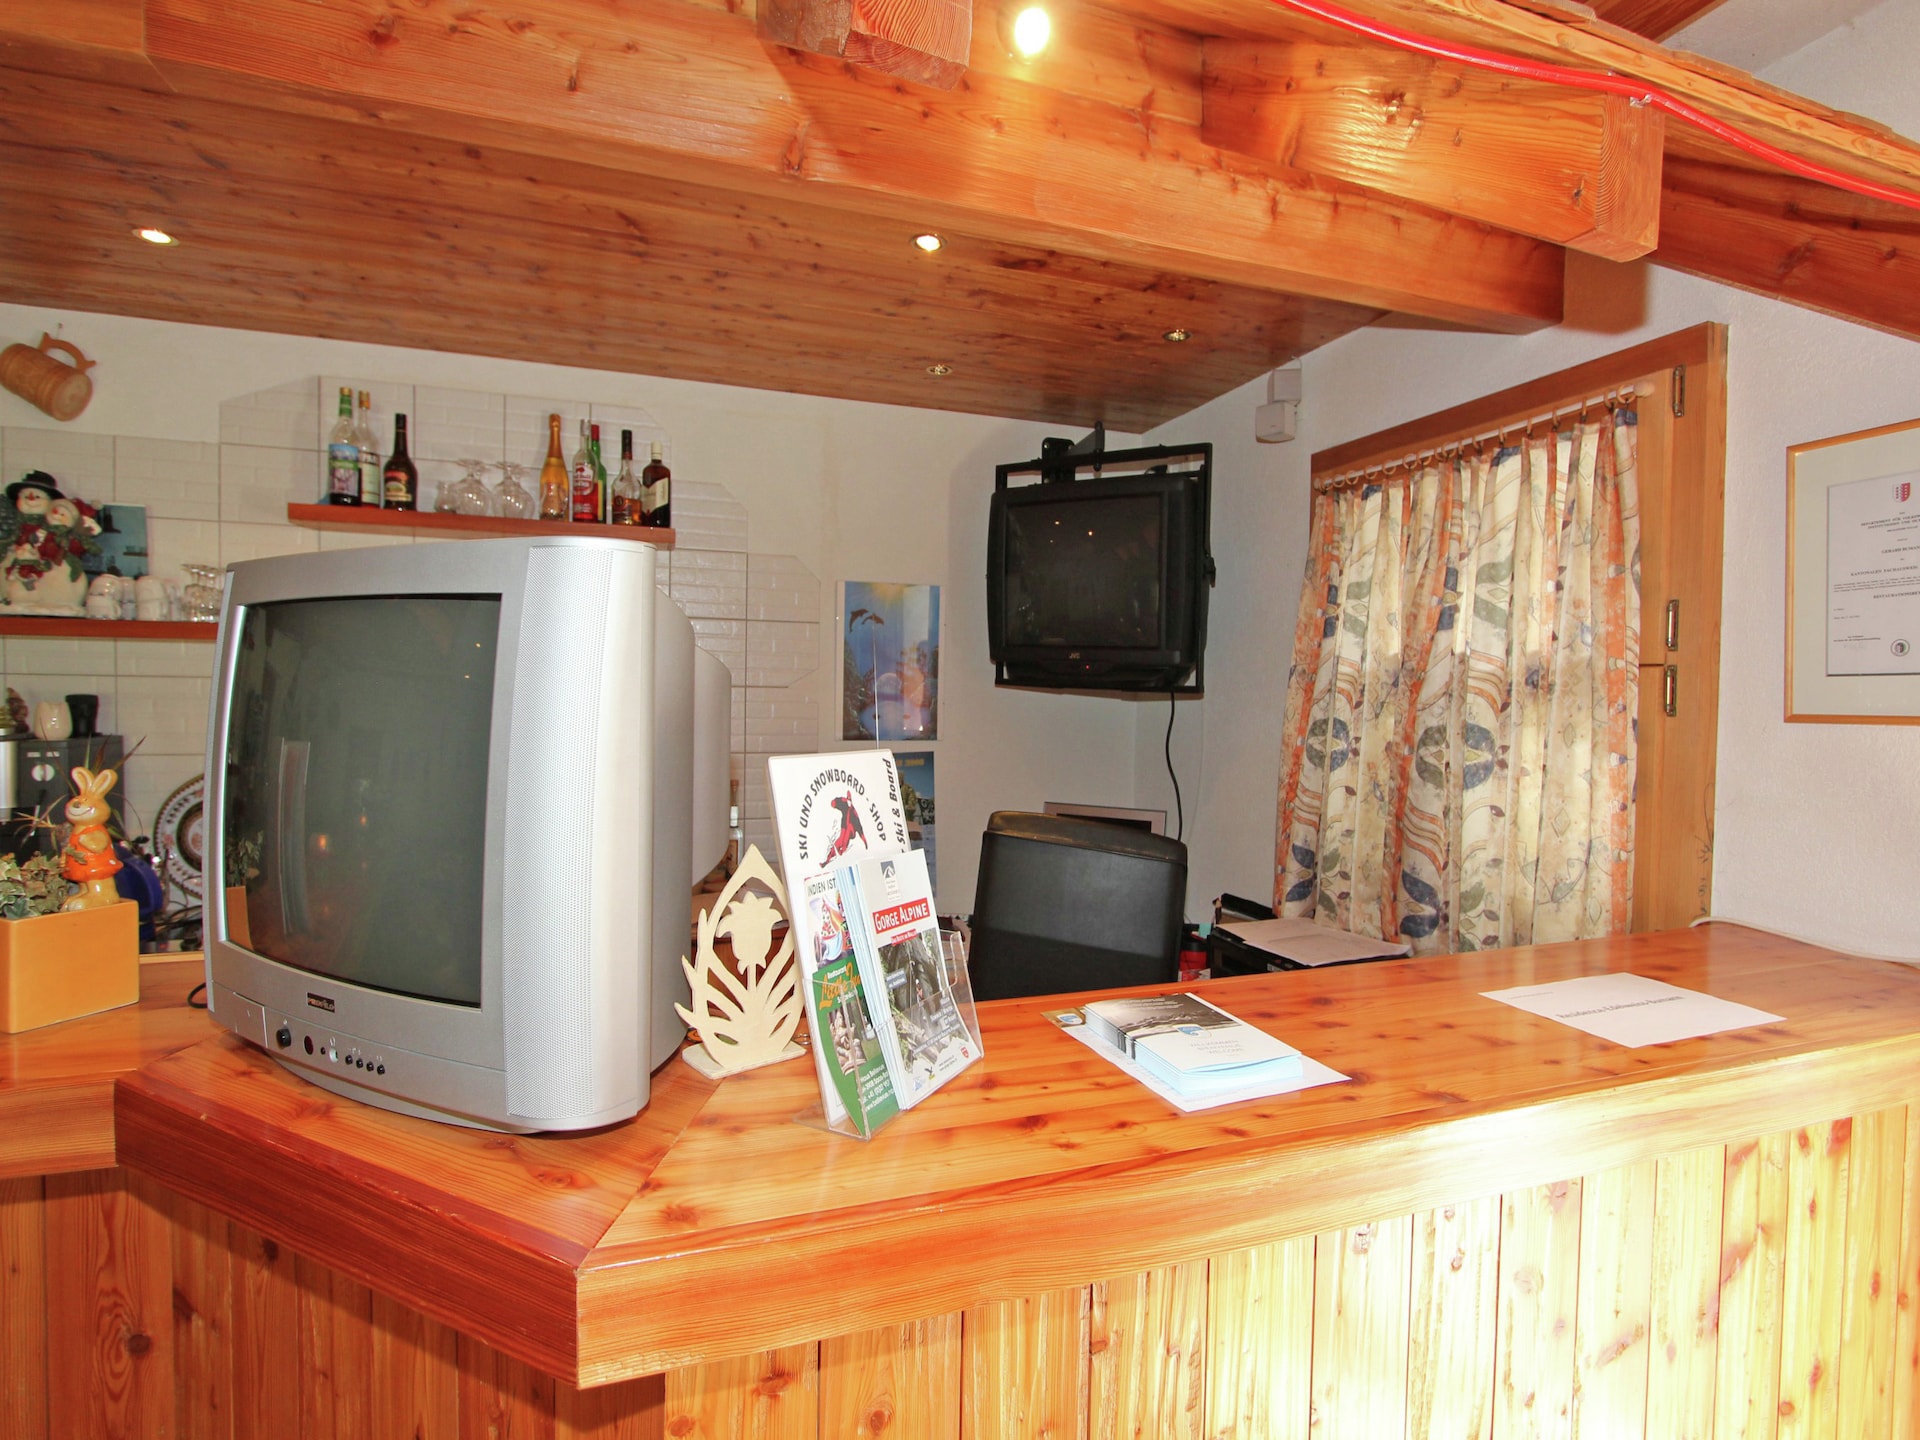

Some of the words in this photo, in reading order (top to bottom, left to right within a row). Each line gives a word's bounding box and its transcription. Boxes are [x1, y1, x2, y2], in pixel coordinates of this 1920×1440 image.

[810, 768, 865, 797] SNOWBOARD
[882, 757, 898, 802] Board
[799, 793, 813, 829] UND
[869, 802, 887, 842] SHOP
[799, 833, 809, 860] SKI
[893, 822, 906, 845] Ski
[807, 881, 826, 897] INDIEN
[874, 911, 899, 931] GORGE
[899, 902, 929, 923] ALPINE
